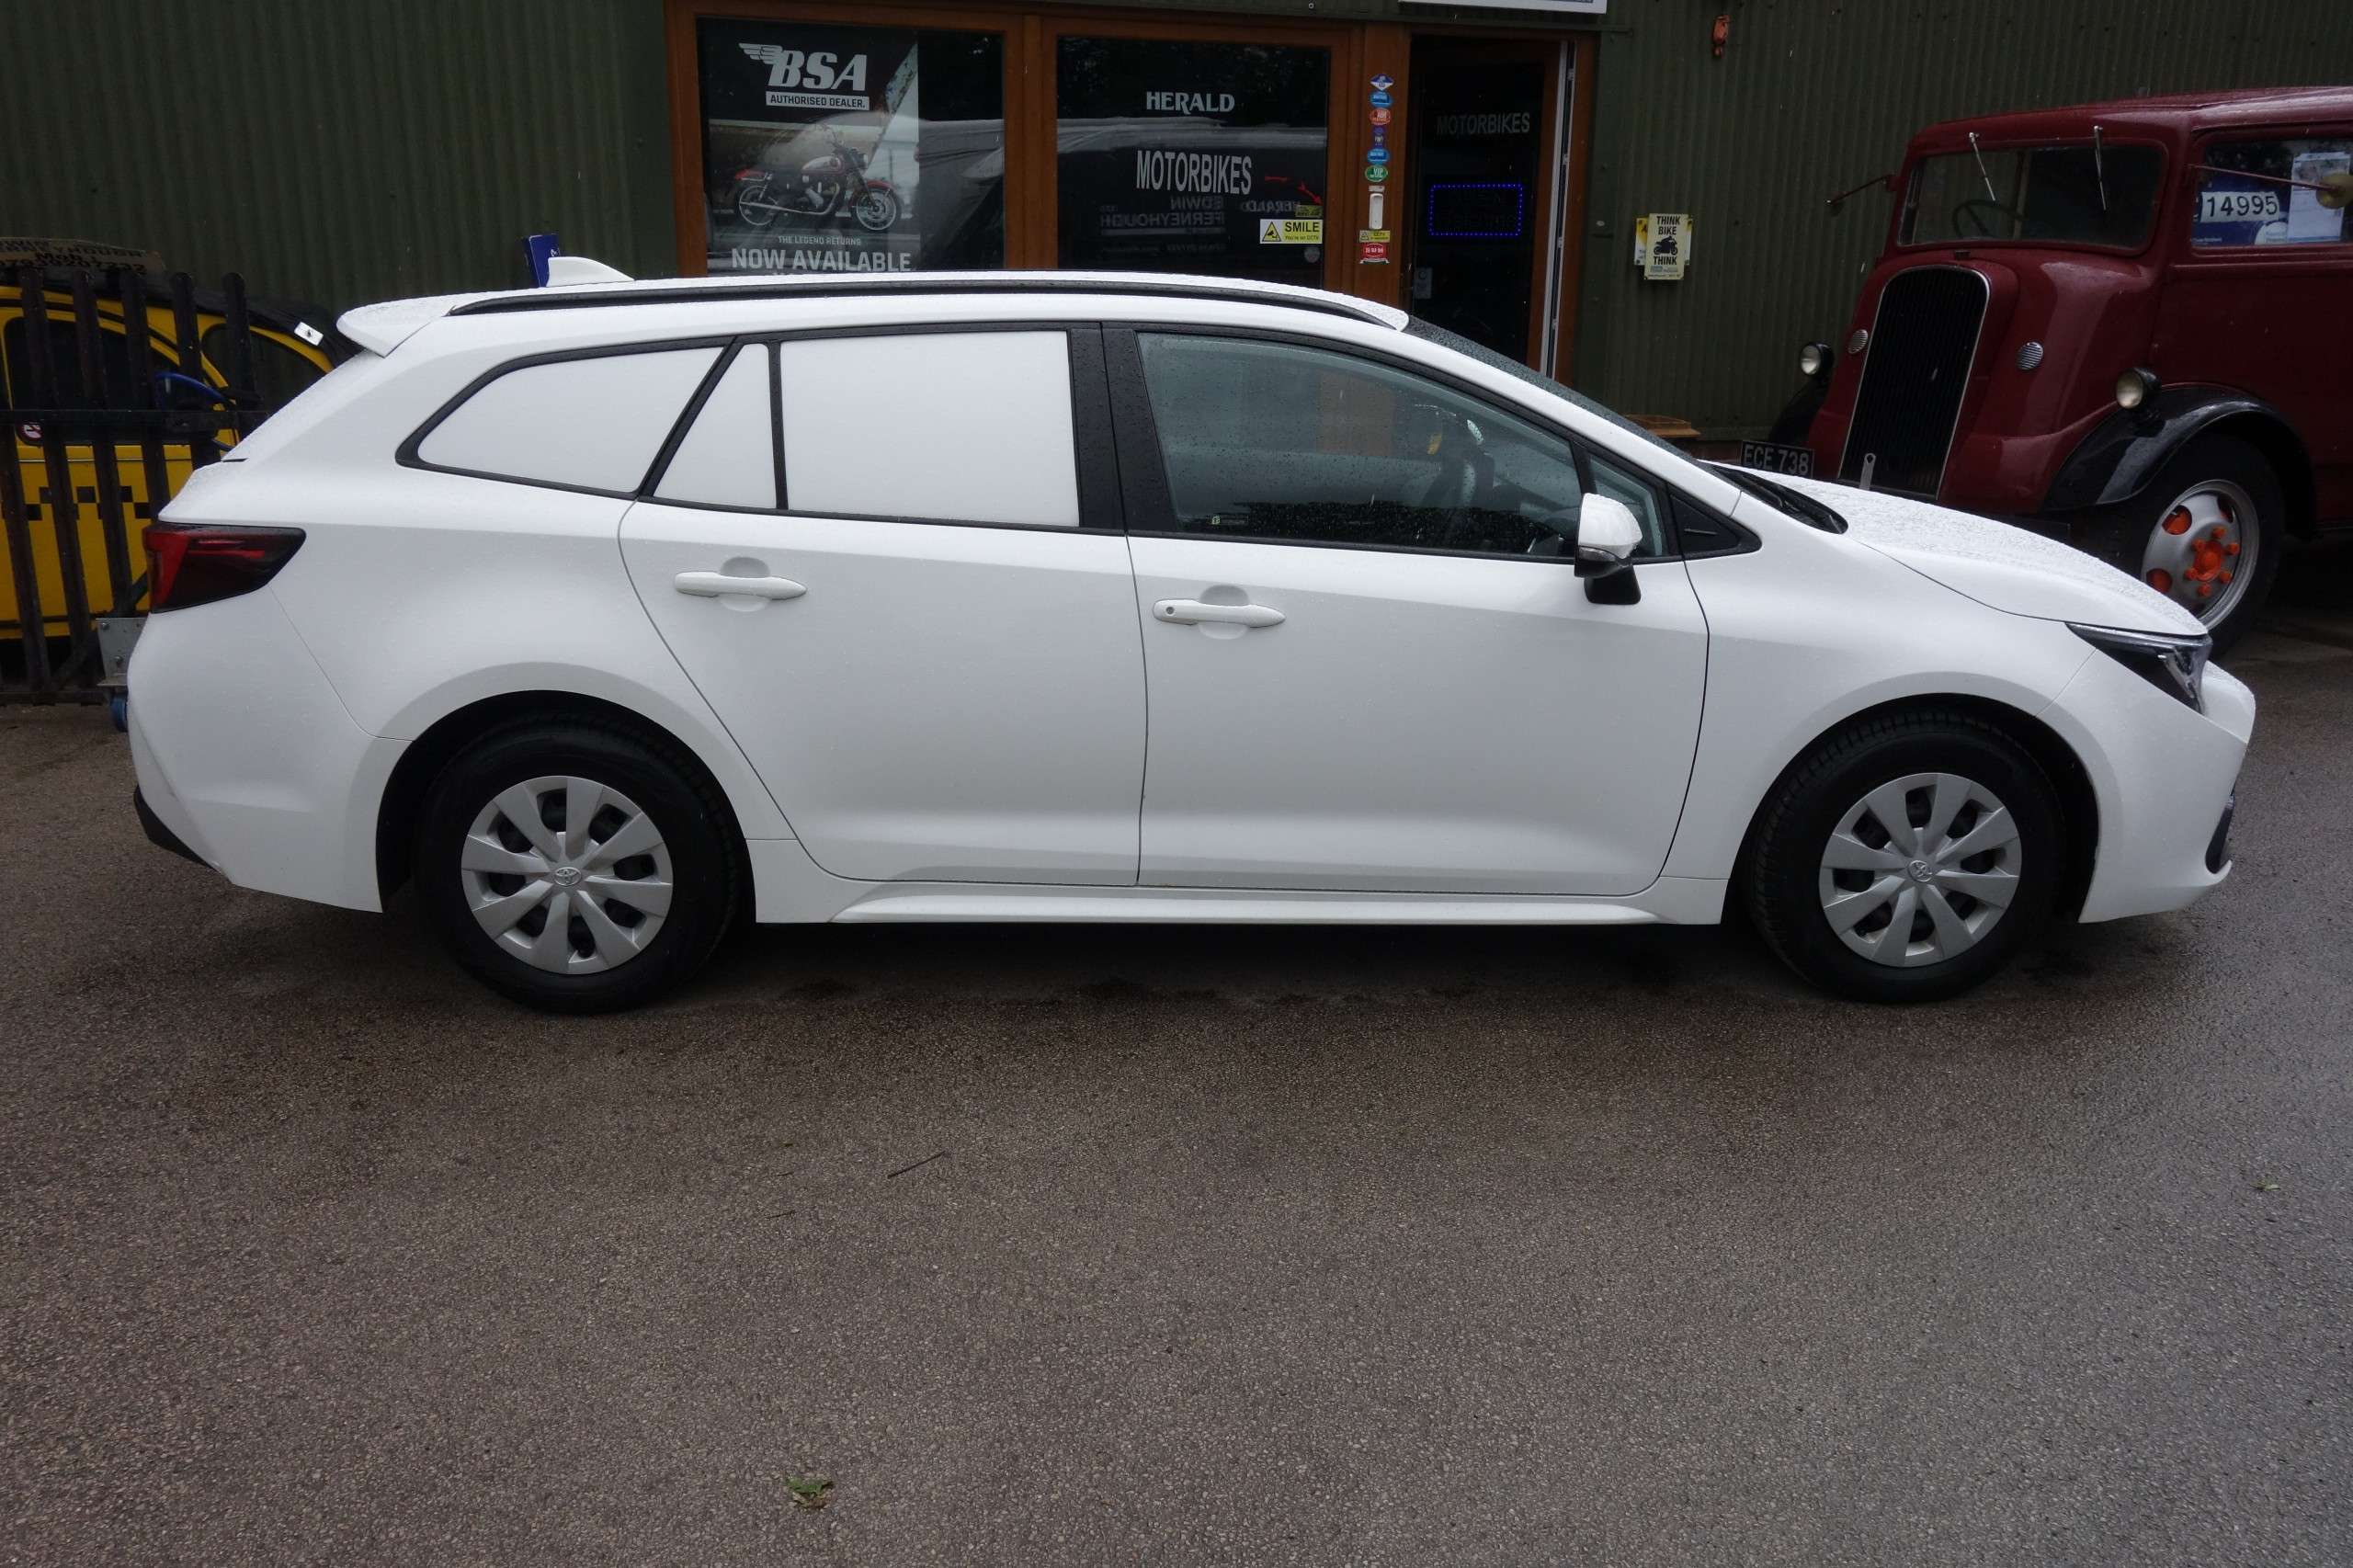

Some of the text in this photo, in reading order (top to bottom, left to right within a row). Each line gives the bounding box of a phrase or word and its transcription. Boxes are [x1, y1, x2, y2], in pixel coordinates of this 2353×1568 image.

[767, 49, 868, 92] BSA
[770, 95, 866, 108] AUTHORISED DEALER.
[1146, 91, 1235, 115] HERALD
[1436, 112, 1530, 135] MOTORBIKES
[1136, 150, 1252, 195] MOTORBIKES
[2207, 195, 2278, 217] 14995
[1285, 222, 1320, 233] SMILE
[1657, 216, 1681, 225] THINK
[1658, 226, 1677, 235] BIKE
[779, 235, 792, 244] THE
[731, 248, 911, 273] NOW AVAILABLE
[1654, 256, 1677, 266] THINK
[1745, 443, 1810, 475] ECE 738
